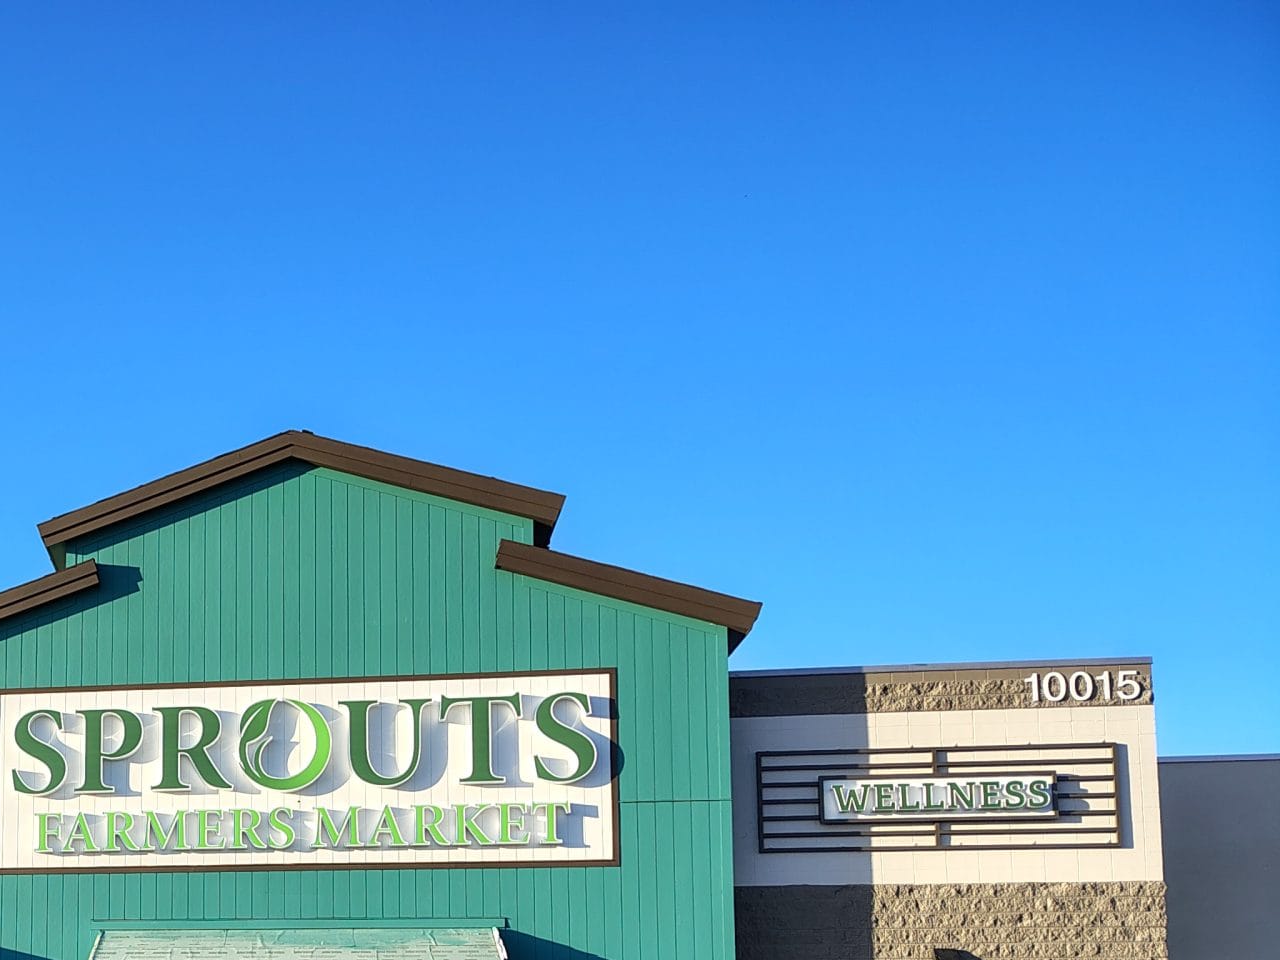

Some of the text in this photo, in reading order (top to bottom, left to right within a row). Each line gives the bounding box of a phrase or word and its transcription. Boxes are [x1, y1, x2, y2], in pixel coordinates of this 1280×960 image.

[1024, 669, 1143, 703] 10015
[11, 692, 598, 793] SPROUTS
[831, 780, 1051, 812] WELLNESS
[34, 800, 572, 854] FARMERS MARKET
